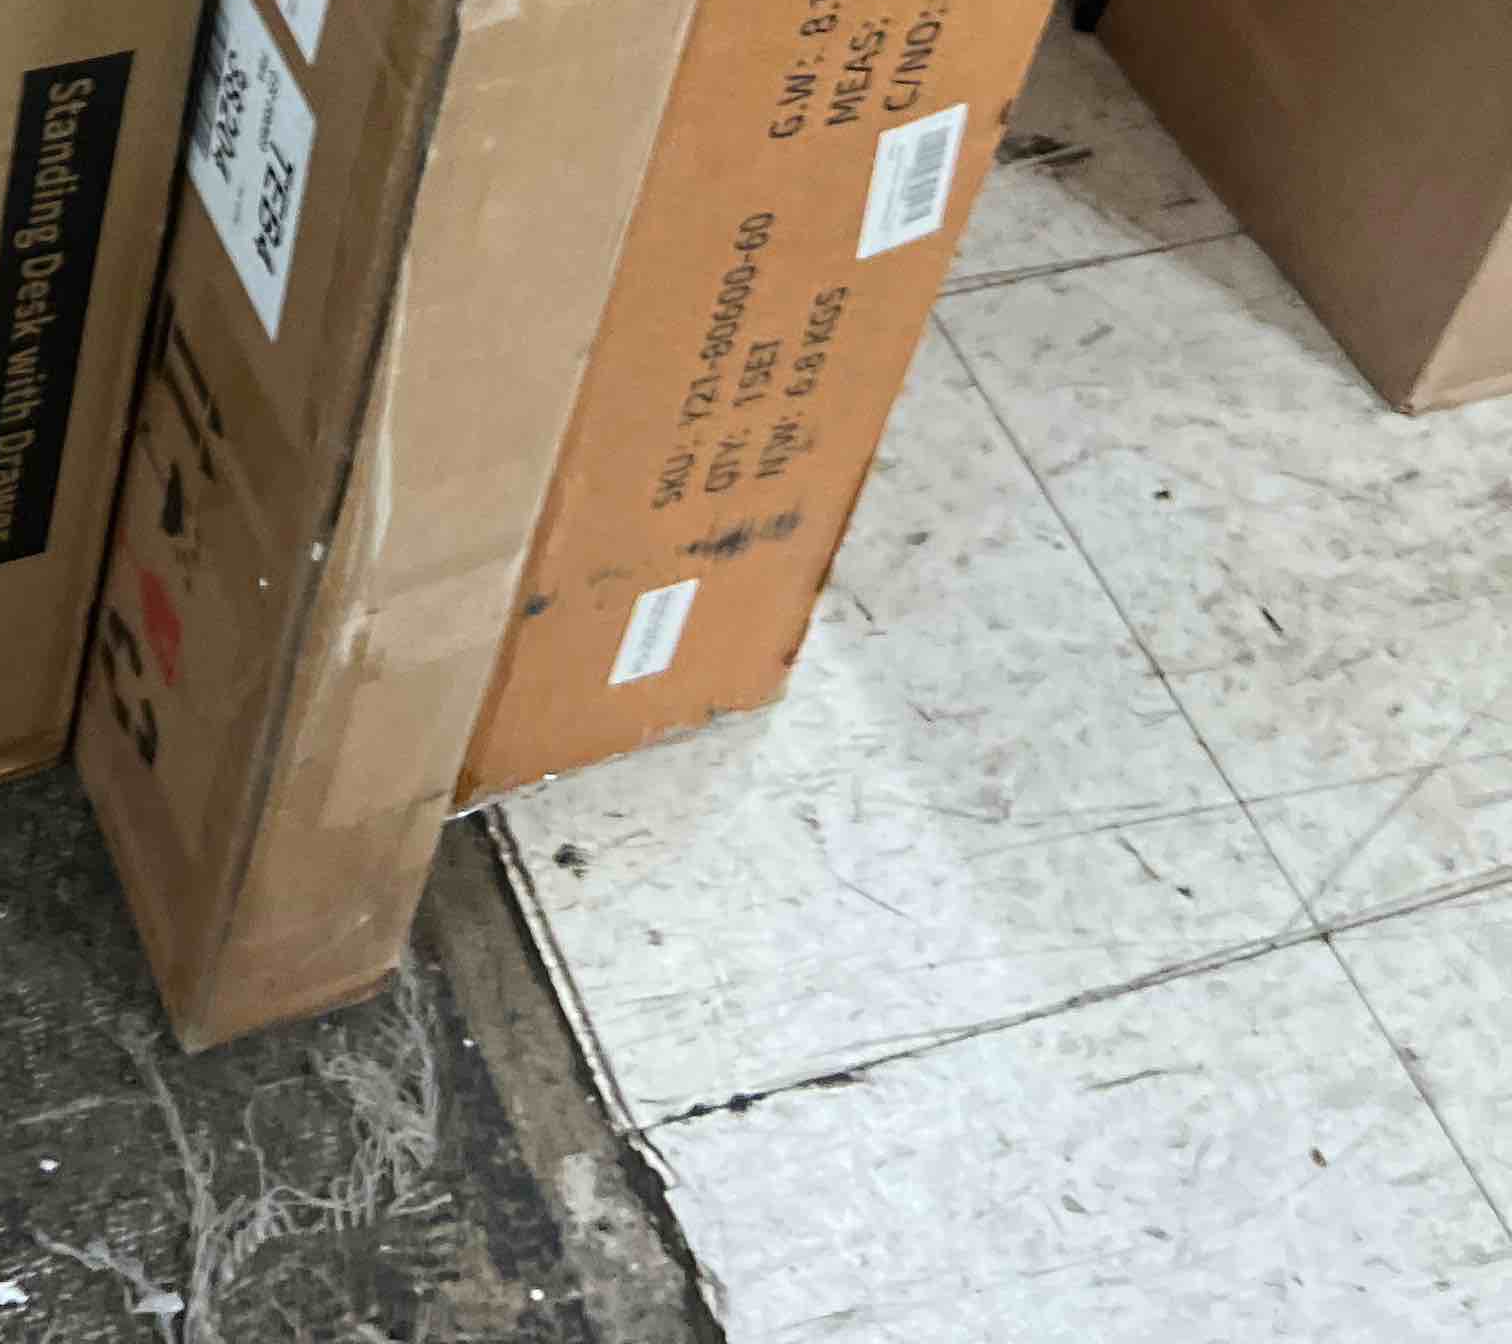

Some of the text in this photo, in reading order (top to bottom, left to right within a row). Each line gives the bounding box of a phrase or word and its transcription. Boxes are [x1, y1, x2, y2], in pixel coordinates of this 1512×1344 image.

[824, 15, 891, 129] MEAS:
[12, 76, 95, 249] Standing
[8, 251, 68, 339] Desk
[803, 285, 849, 347] KGS
